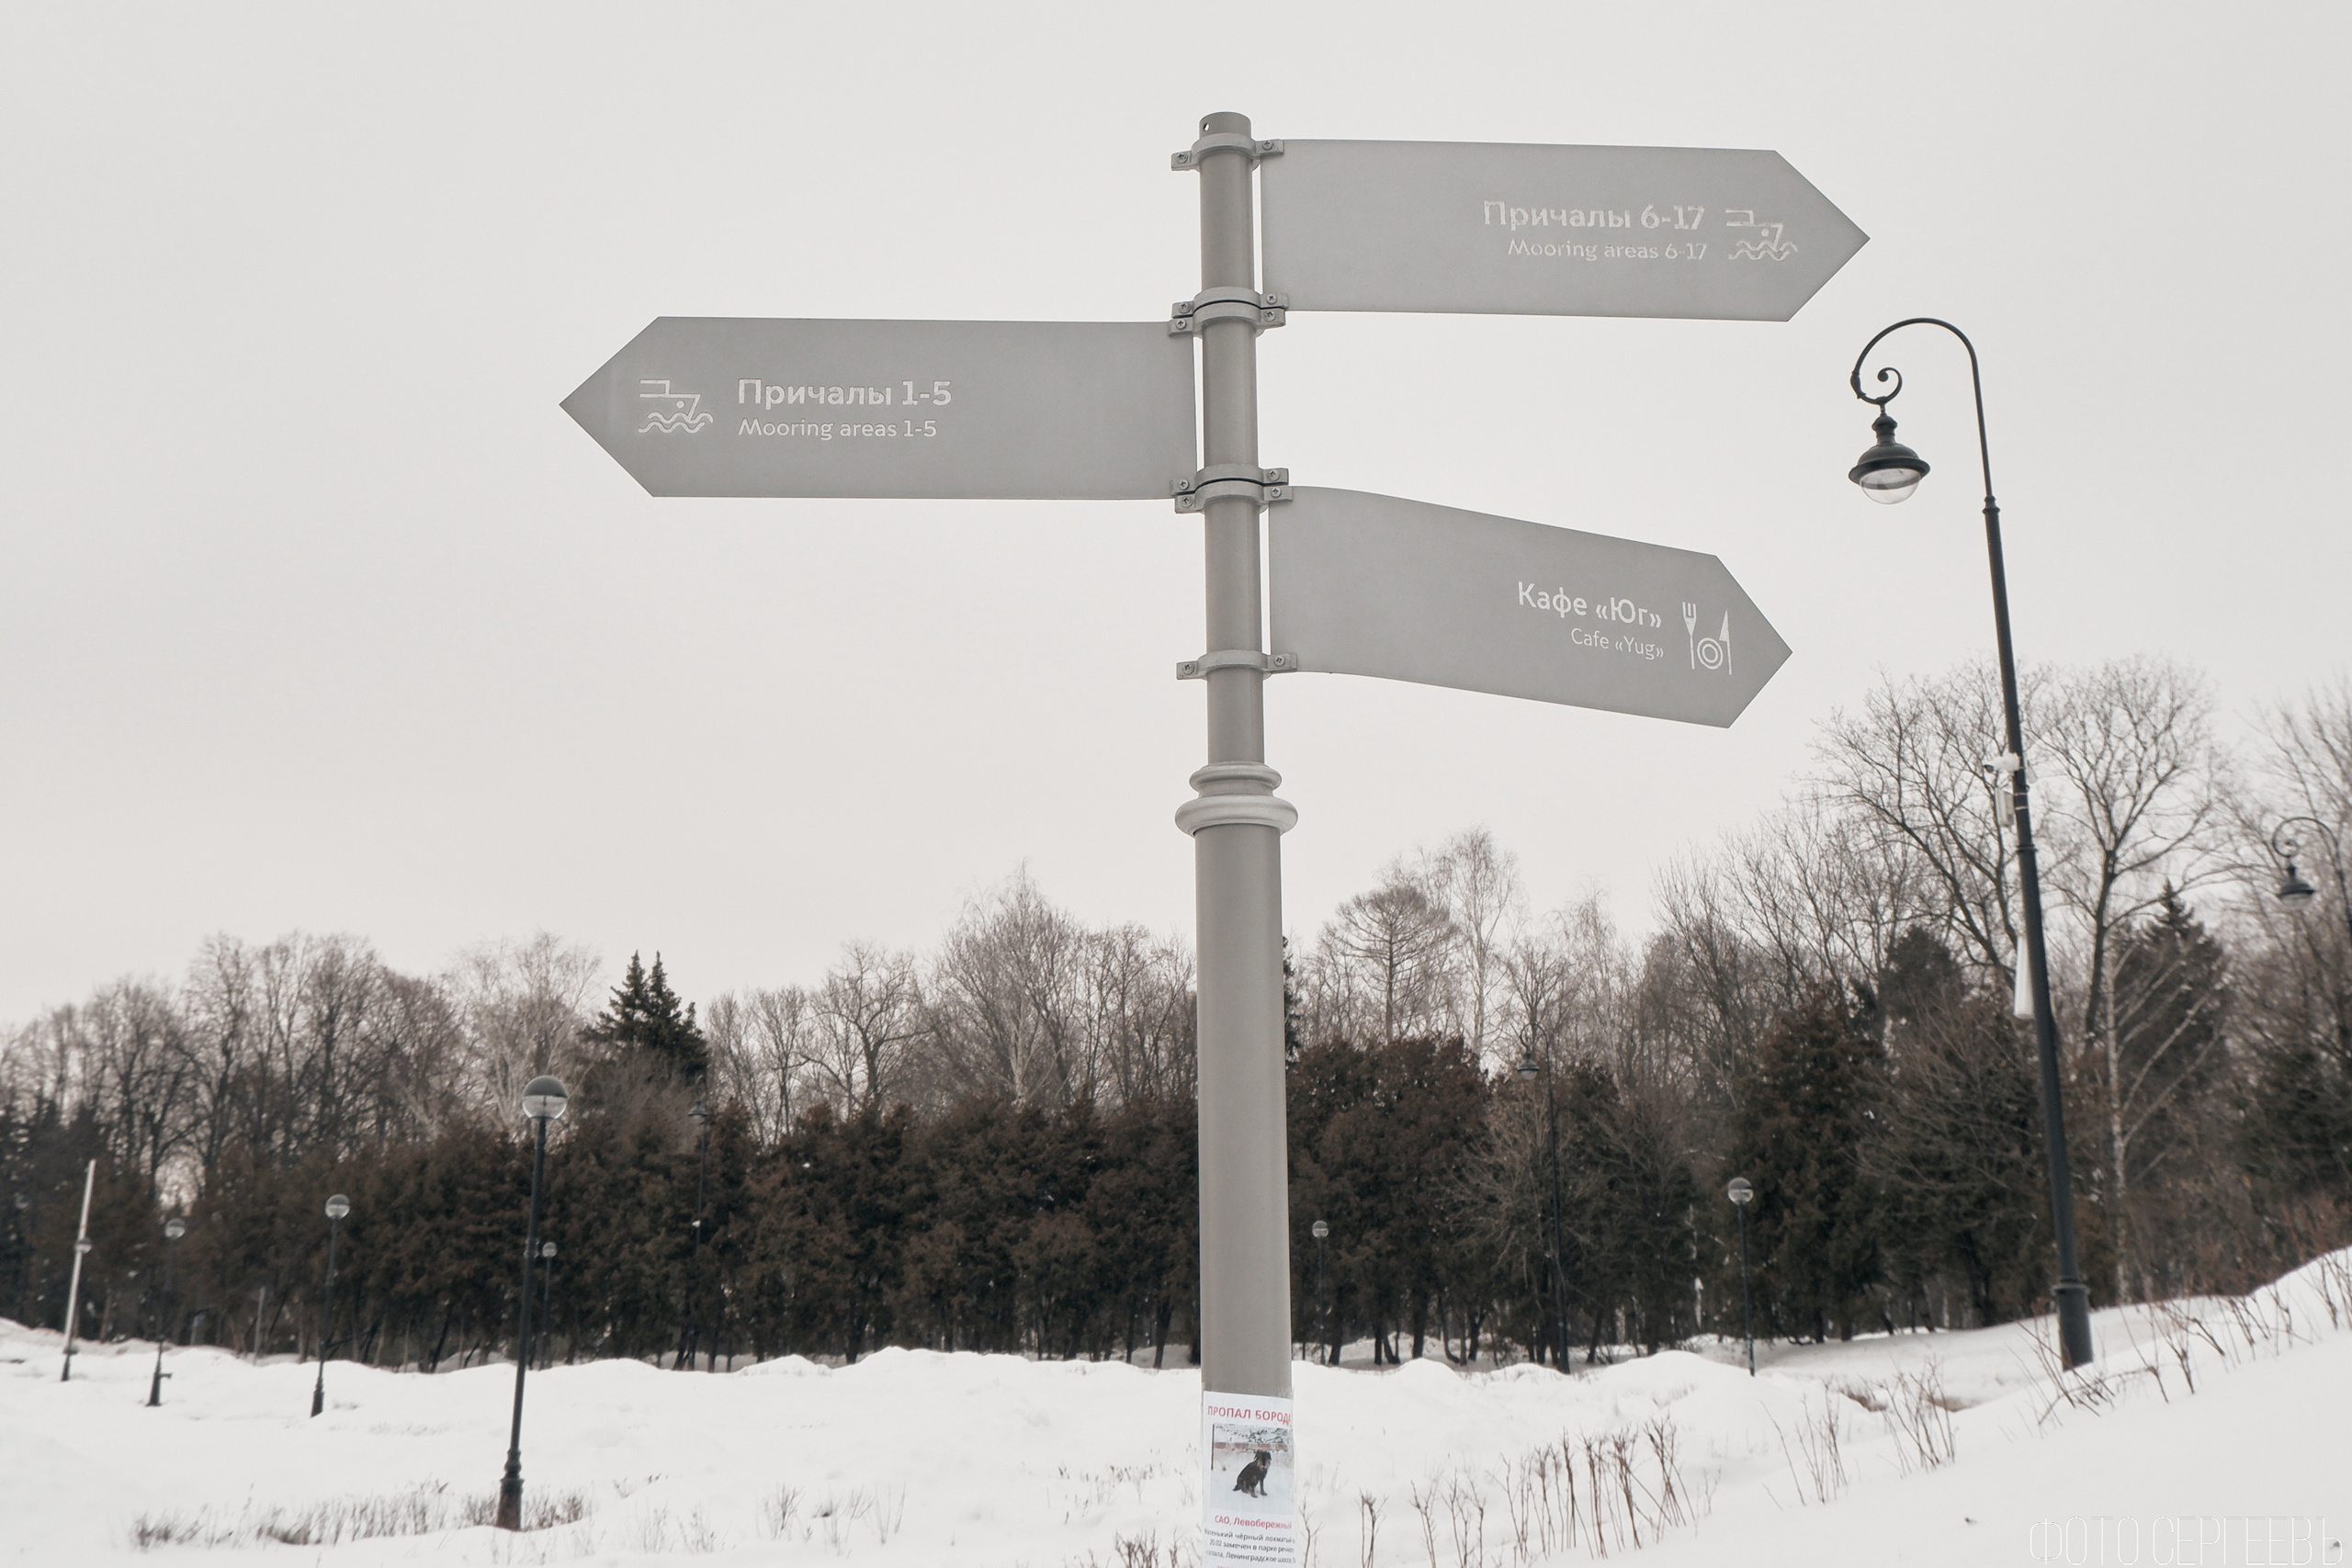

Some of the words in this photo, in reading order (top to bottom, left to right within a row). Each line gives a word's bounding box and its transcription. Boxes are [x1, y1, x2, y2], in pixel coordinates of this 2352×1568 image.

[1483, 199, 1632, 231] Причалы
[1641, 203, 1706, 231] 6-17
[1508, 238, 1598, 263] Mooring
[1603, 243, 1659, 260] areas
[1664, 243, 1708, 261] 6-17
[738, 378, 892, 411] Причалы
[901, 380, 953, 407] 1-5
[738, 417, 833, 441] Mooring
[840, 422, 898, 438] areas
[903, 419, 938, 438] 1-5
[1518, 581, 1589, 619] Кафе
[1595, 596, 1663, 628] «Юг»
[1570, 627, 1610, 649] Cafe
[1614, 635, 1665, 660] «Yug»
[1207, 1405, 1252, 1419] ПРОПАЛ
[1215, 1515, 1232, 1526] САО,
[1223, 1541, 1251, 1551] замечен
[1258, 1545, 1278, 1553] парке
[1234, 1532, 1264, 1541] чёрный
[1225, 1551, 1277, 1562] Ленинградское
